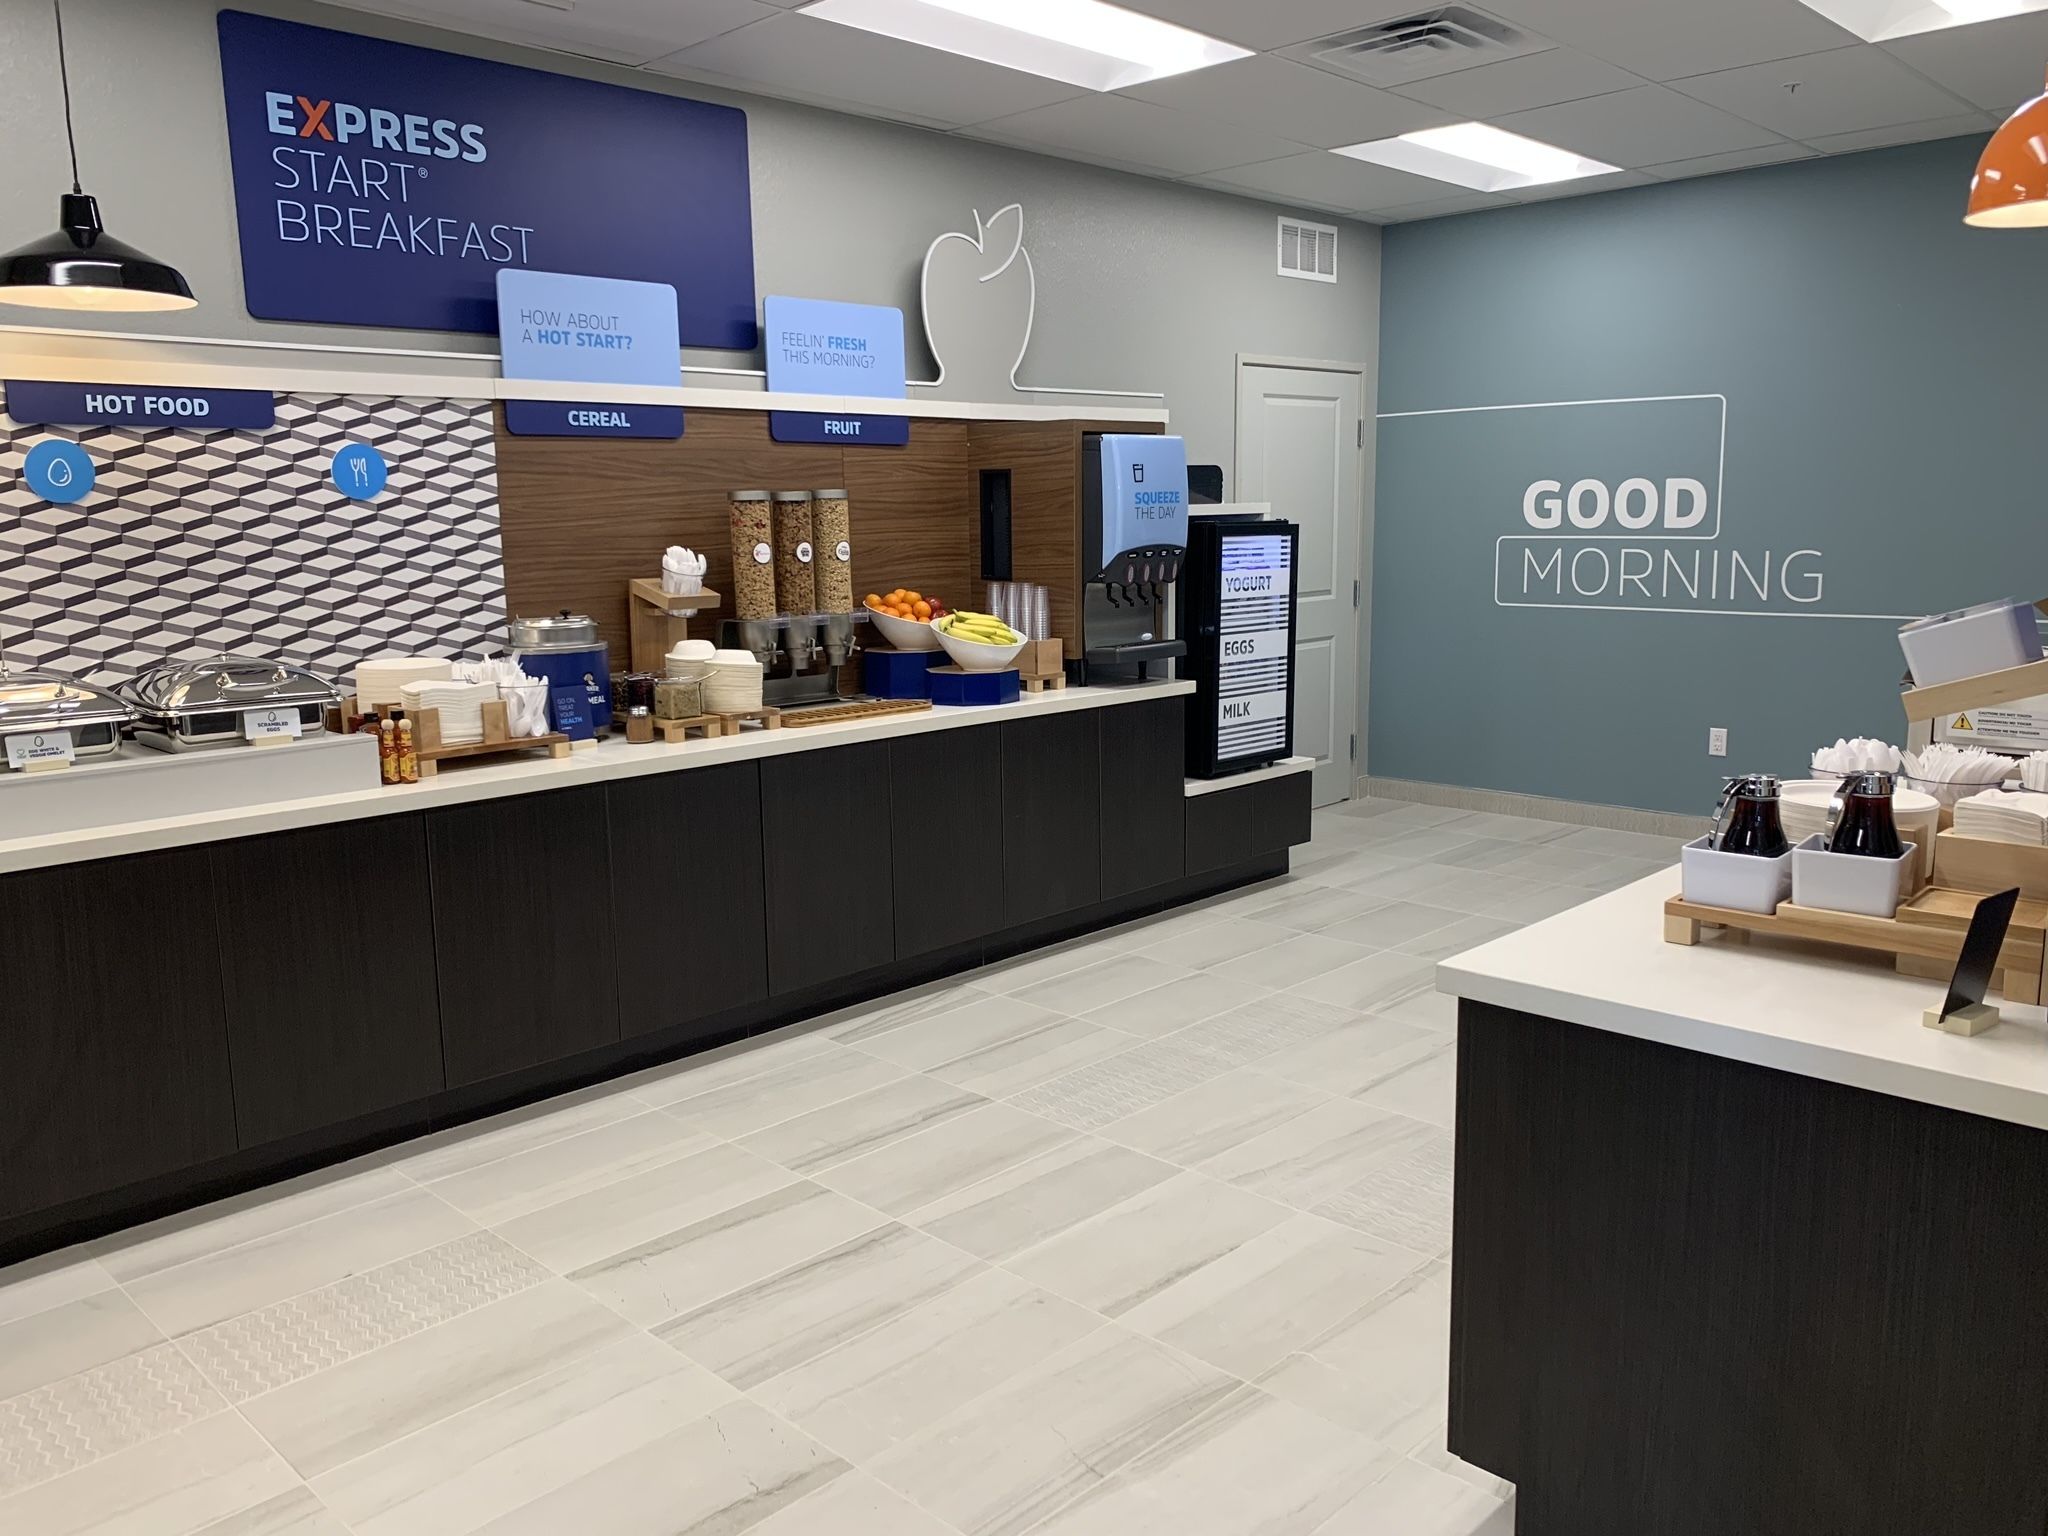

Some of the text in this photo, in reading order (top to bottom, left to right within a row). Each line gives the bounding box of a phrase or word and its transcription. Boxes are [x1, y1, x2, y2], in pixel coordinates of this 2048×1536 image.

[265, 91, 488, 163] EXPRESS
[276, 199, 535, 264] BREAKFAST
[520, 308, 620, 331] HOW ABOUT
[522, 328, 633, 350] A HOT START?
[782, 331, 867, 352] FEELIN' FRESH
[782, 348, 876, 370] THIS MORNING?
[85, 394, 210, 417] HOT FOOD
[567, 410, 631, 428] CEREAL
[823, 420, 862, 435] FRUIT
[1134, 491, 1180, 506] SQUEEZE
[1522, 477, 1708, 530] GOOD
[1134, 506, 1177, 520] THE DAY
[1225, 575, 1272, 593] YOGURT
[1522, 547, 1824, 603] MORNING
[1224, 638, 1255, 657] EGGS
[1223, 701, 1251, 720] MILK
